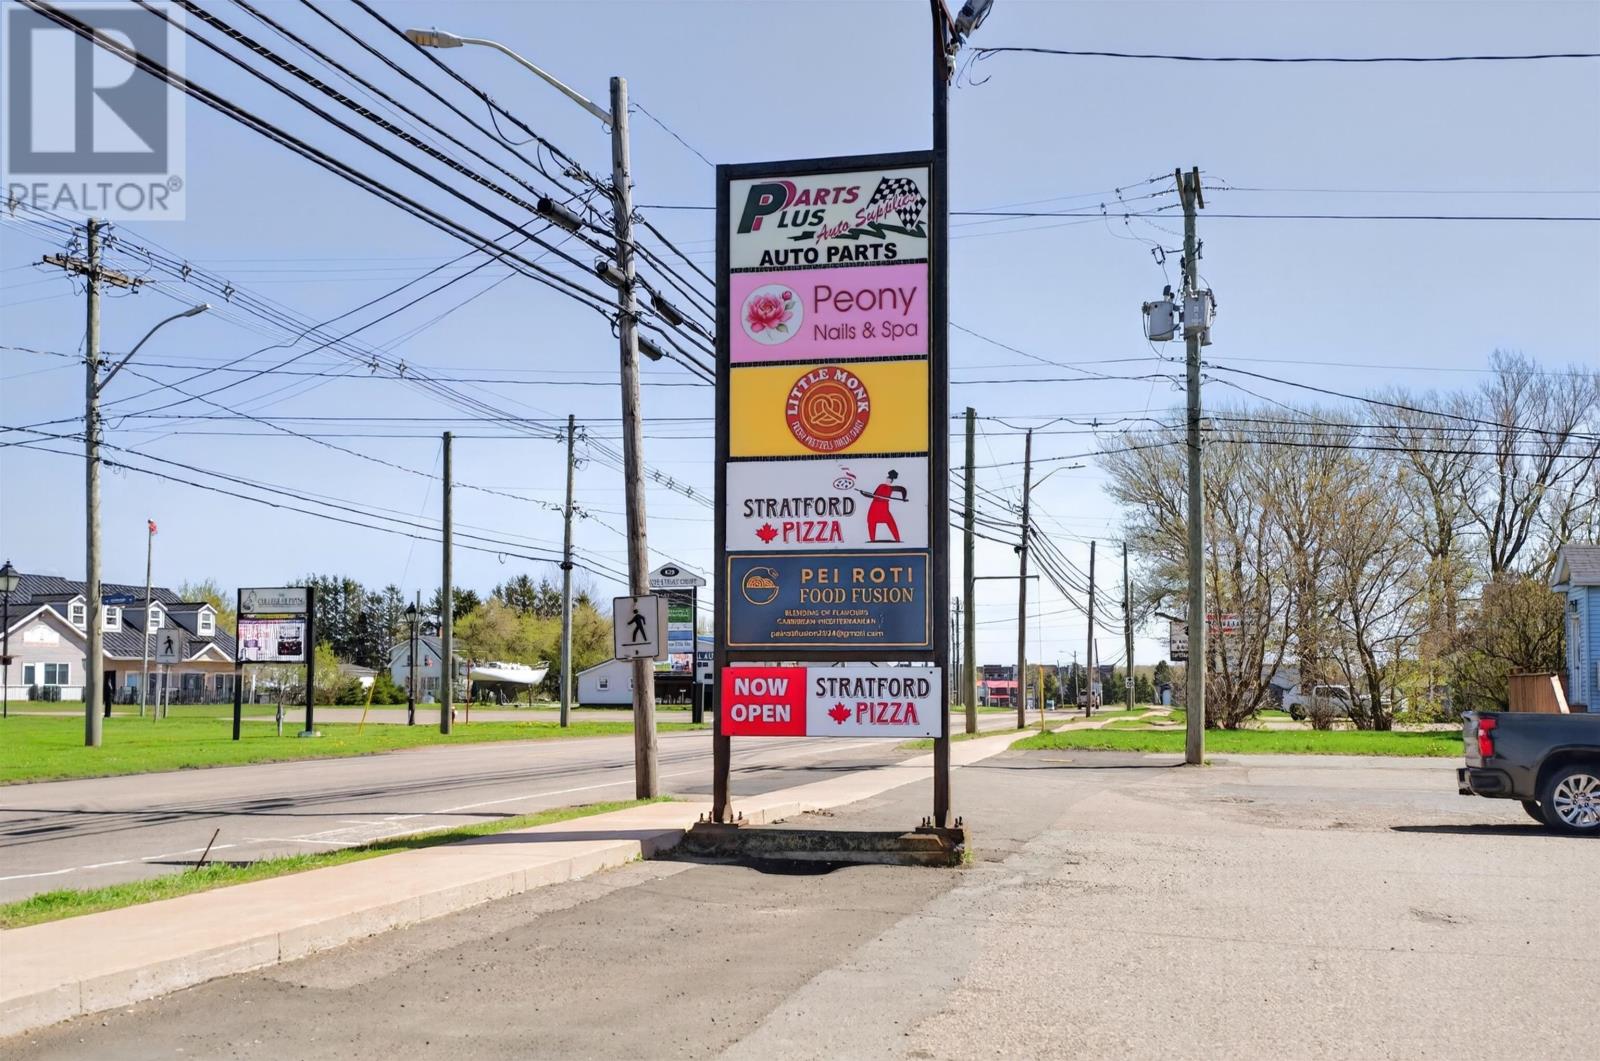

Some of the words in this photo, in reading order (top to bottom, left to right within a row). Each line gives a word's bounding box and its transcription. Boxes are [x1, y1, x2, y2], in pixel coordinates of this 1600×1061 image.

[737, 183, 826, 234] PLUS
[756, 180, 861, 214] PARTS
[816, 220, 850, 245] Auto
[759, 247, 819, 267] AUTO
[827, 242, 898, 263] PARTS
[813, 285, 918, 316] Peony
[814, 323, 857, 341] Nails
[863, 322, 876, 338] &
[881, 320, 918, 341] Spa
[787, 368, 830, 416] LITTLE
[834, 368, 870, 413] MONK
[743, 497, 856, 518] STRATFORD
[783, 520, 845, 544] PIZZA
[801, 567, 839, 584] PEI
[852, 566, 913, 584] ROTI
[800, 588, 846, 604] FOOD
[851, 587, 915, 603] FUSION
[734, 678, 789, 697] NOW
[815, 677, 930, 698] STRATFORD
[731, 704, 791, 722] OPEN
[856, 702, 920, 725] PIZZA
